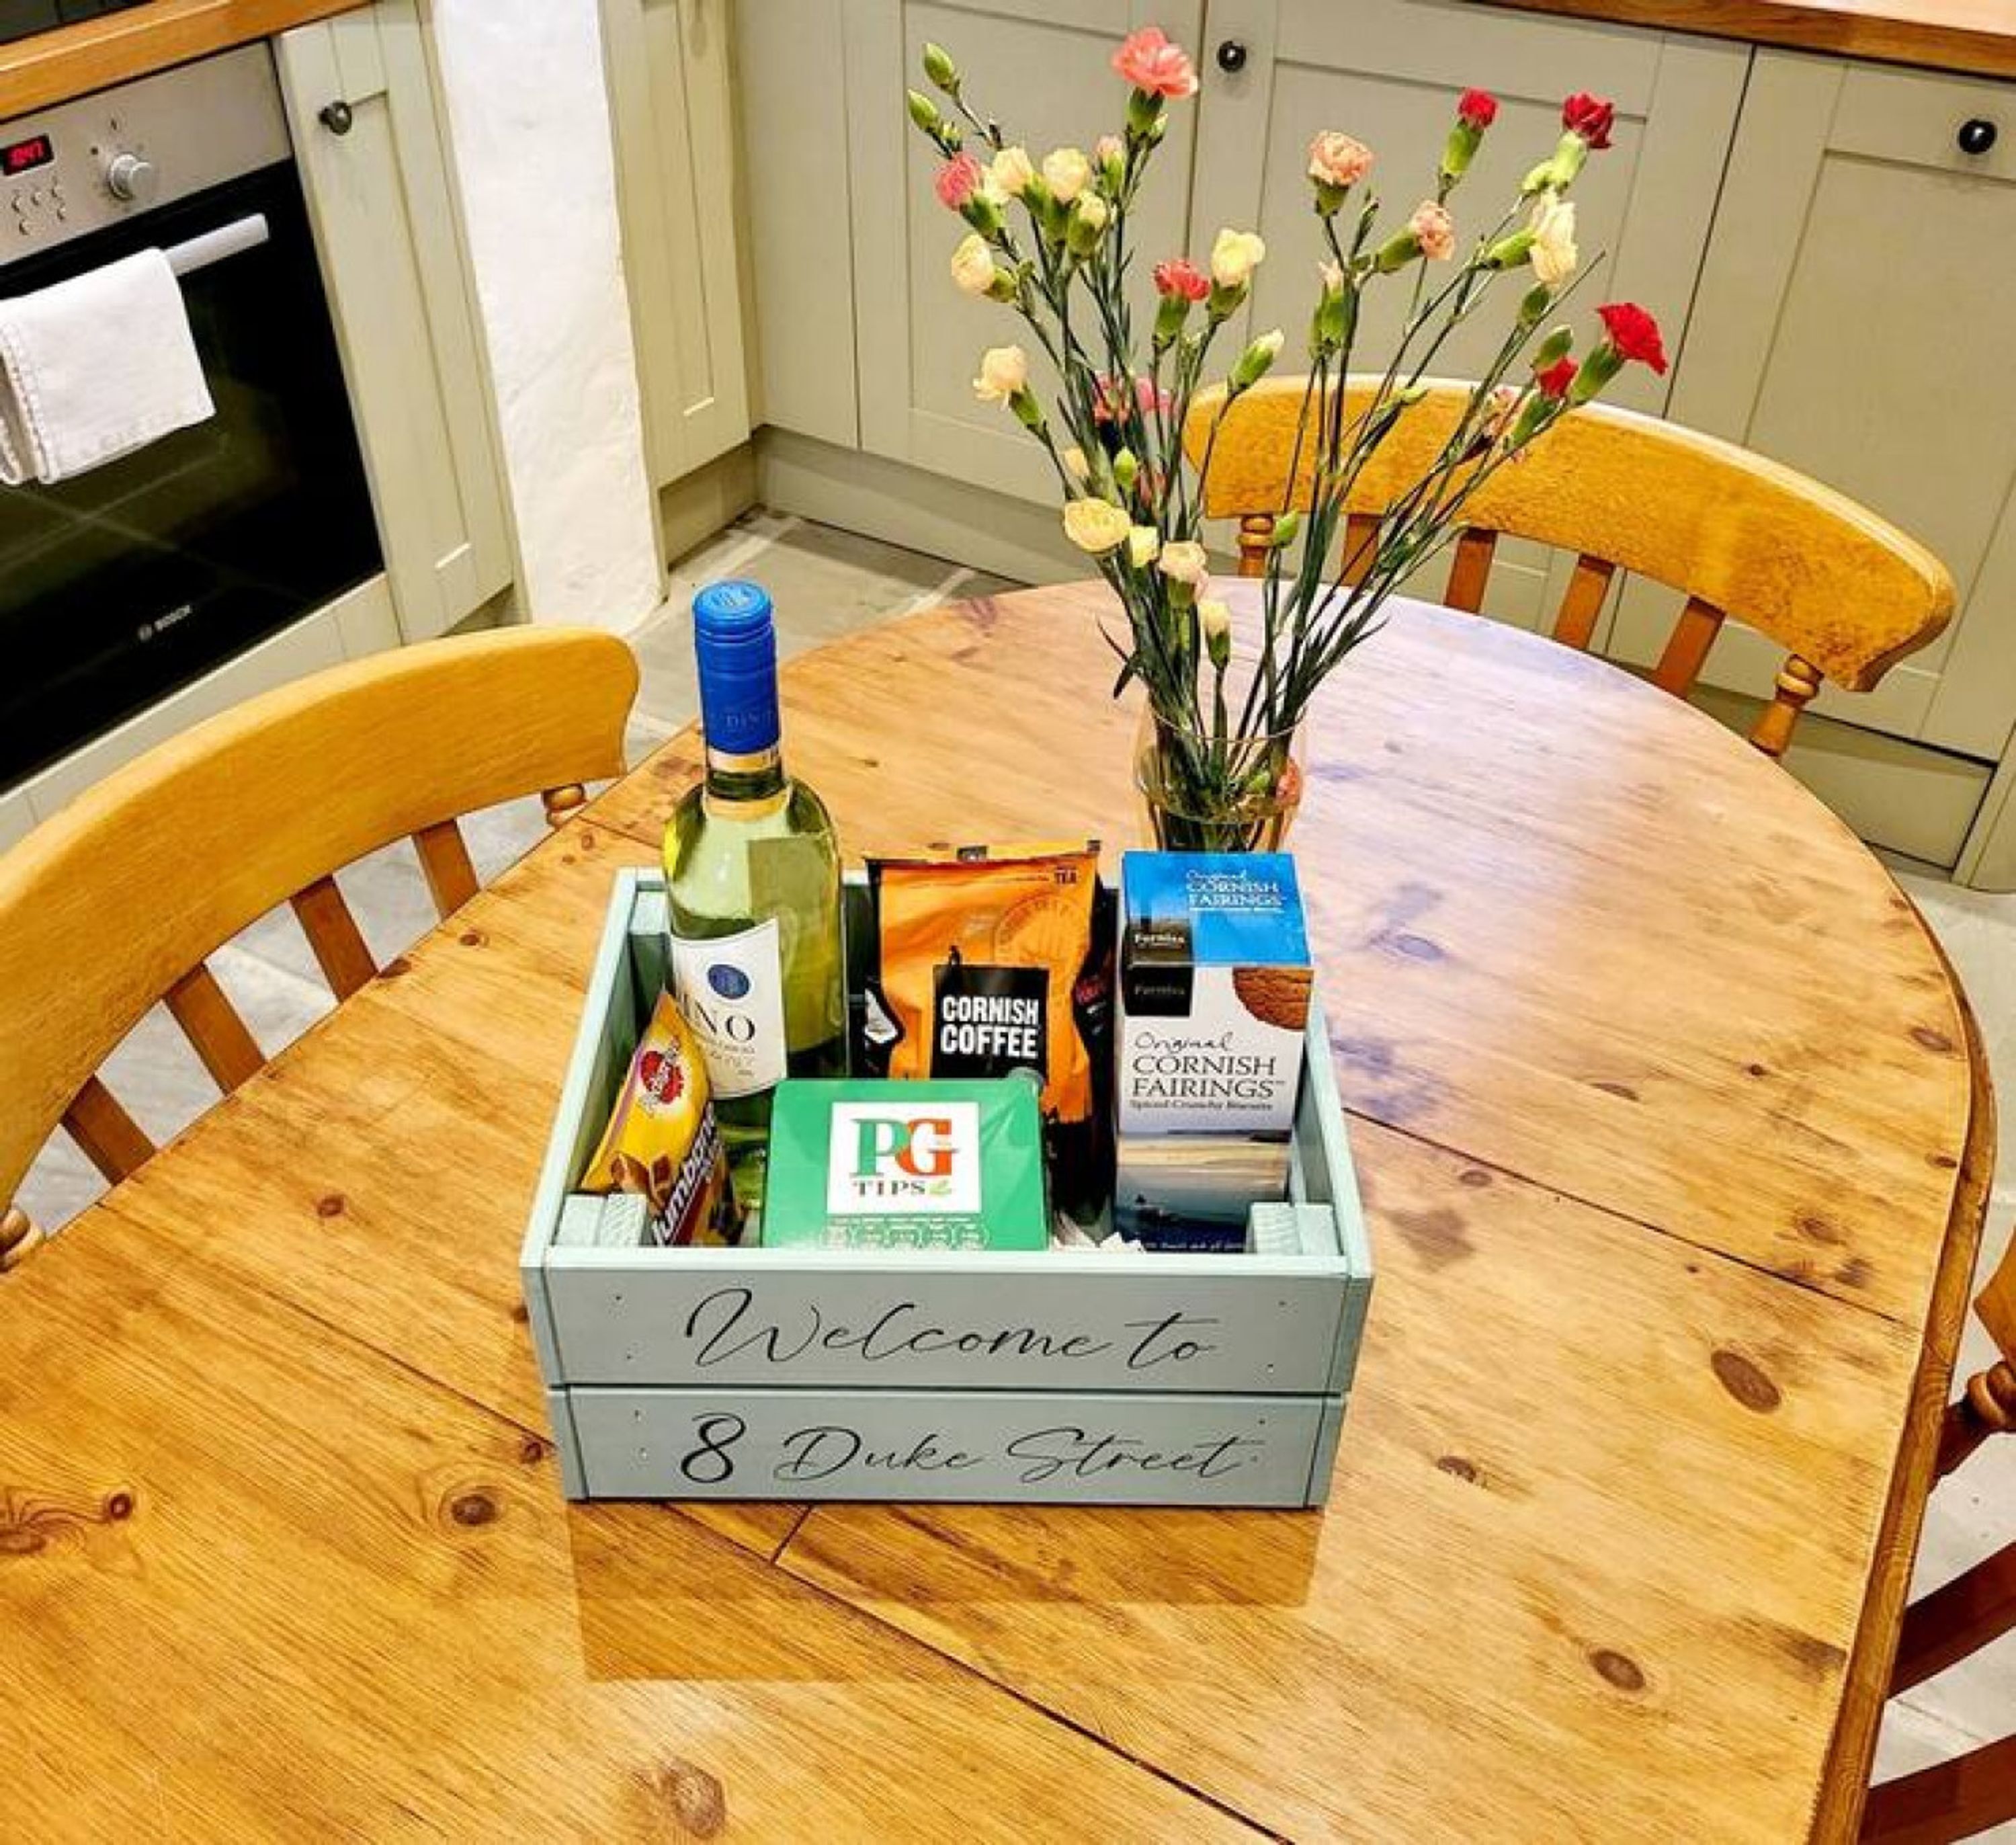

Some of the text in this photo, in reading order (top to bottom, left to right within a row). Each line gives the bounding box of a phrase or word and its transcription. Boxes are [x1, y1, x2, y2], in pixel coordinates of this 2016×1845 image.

[1187, 882, 1280, 894] CORNISH
[941, 993, 1040, 1025] CORNISH
[941, 1024, 1038, 1059] COFFEE
[1134, 1031, 1234, 1054] Original
[1132, 1055, 1277, 1075] CORNISH
[1132, 1077, 1276, 1098] FAIRINGS
[849, 1117, 960, 1176] PG
[851, 1180, 927, 1196] TIPS
[685, 1288, 1220, 1370] Welcome to
[680, 1412, 1266, 1483] 8 Duke Street
